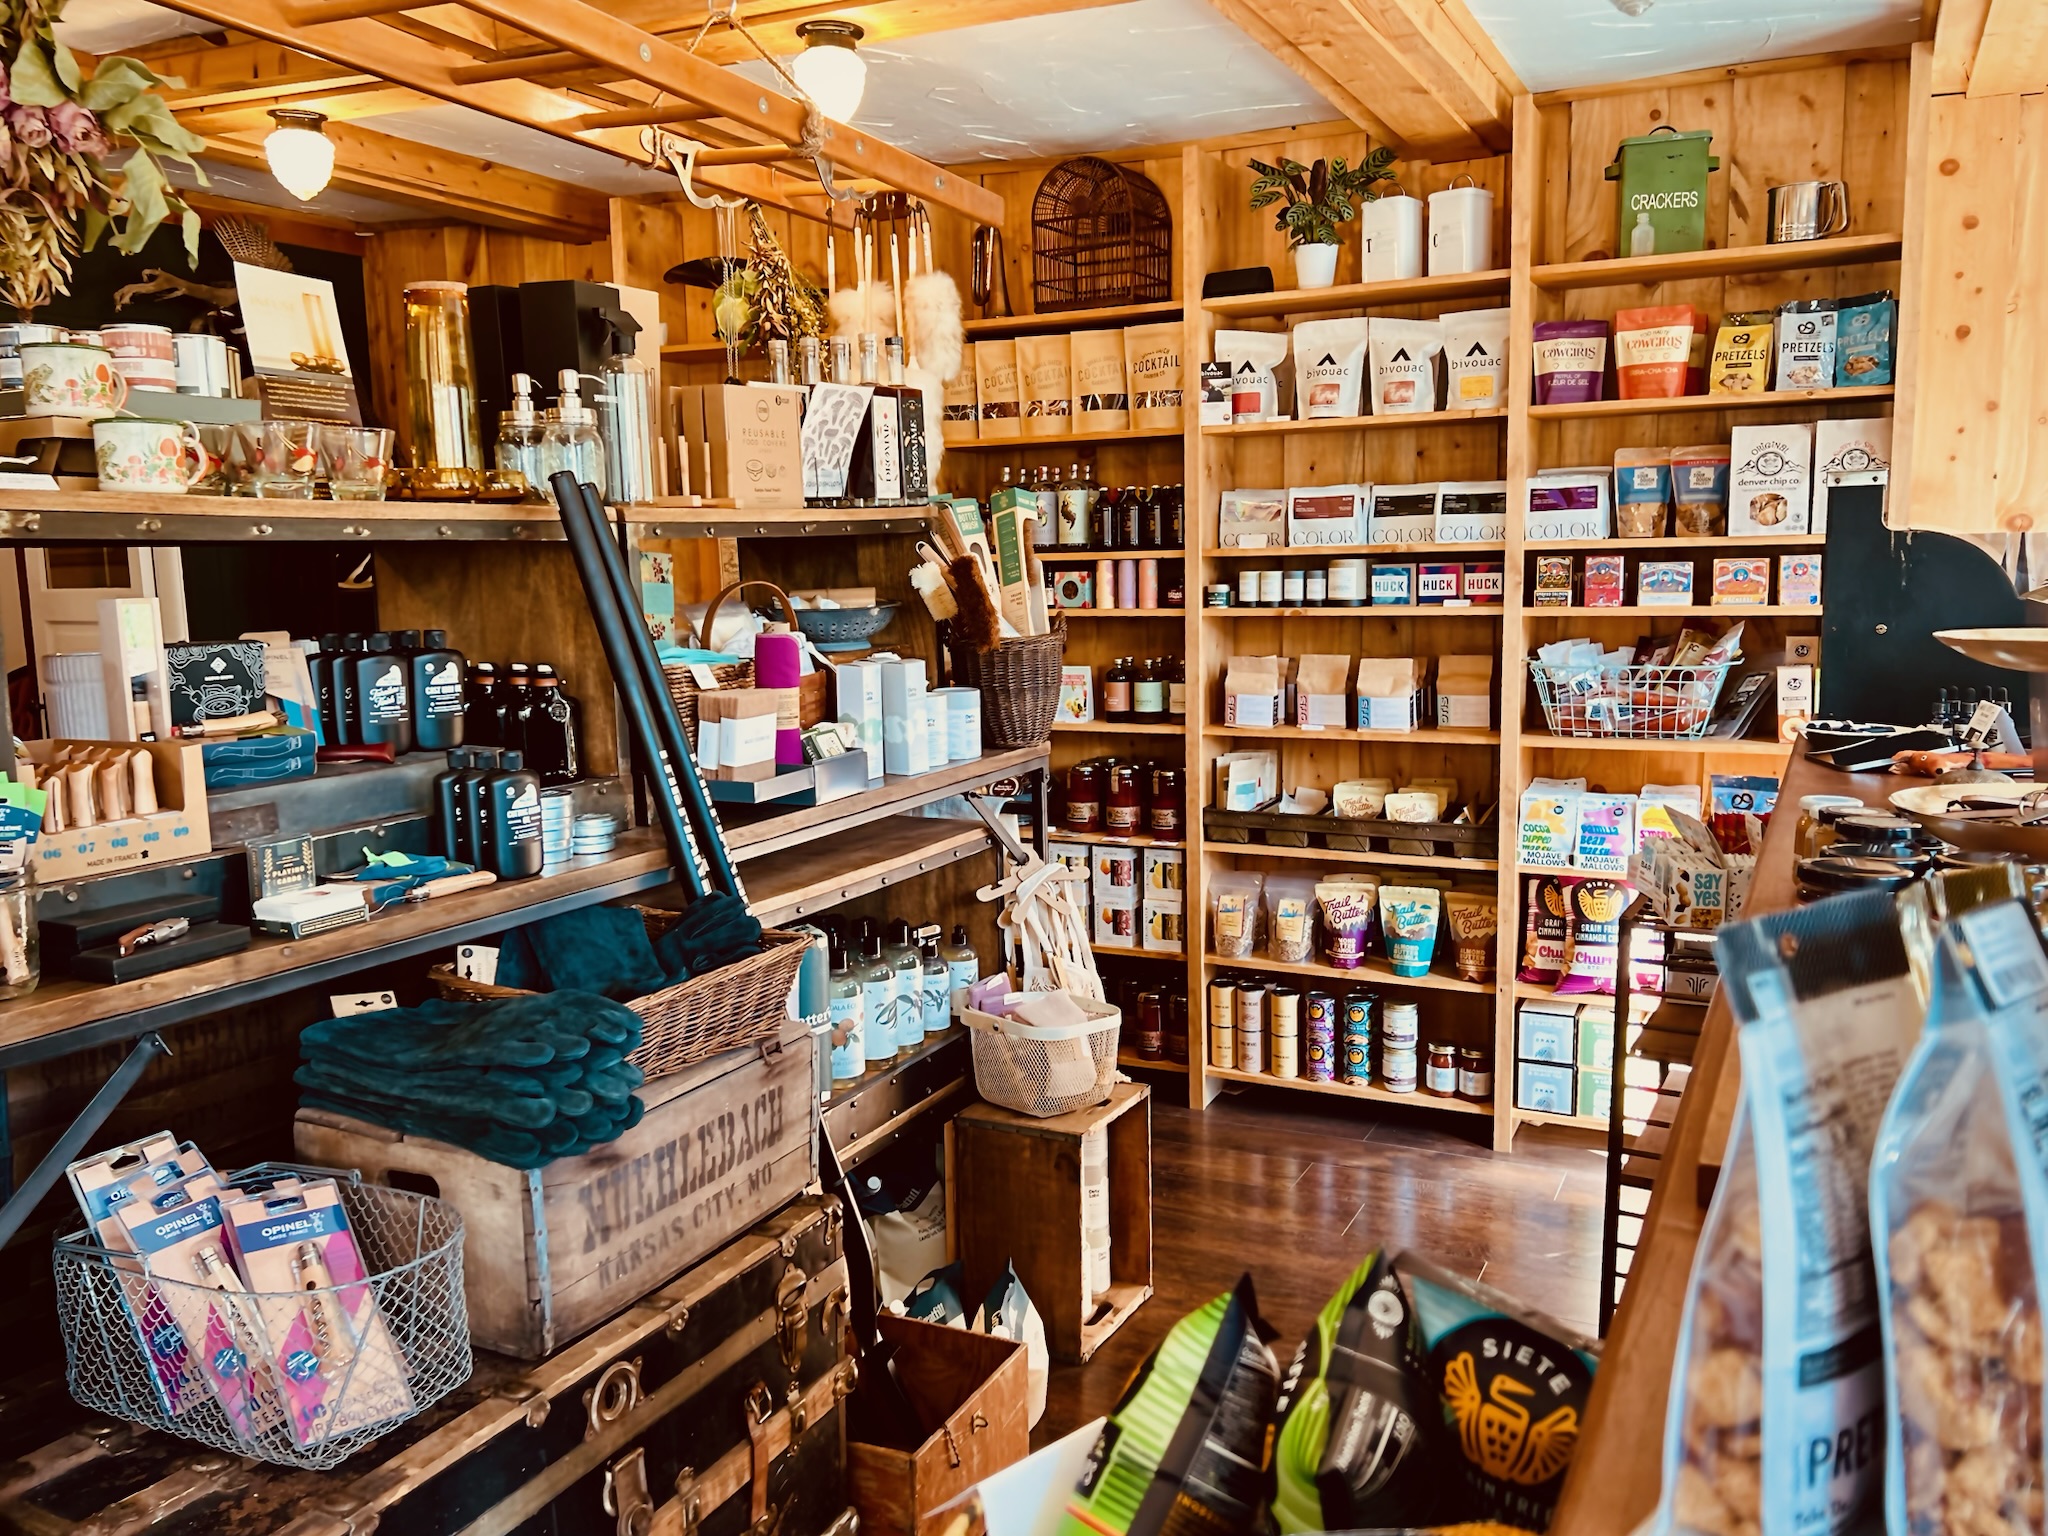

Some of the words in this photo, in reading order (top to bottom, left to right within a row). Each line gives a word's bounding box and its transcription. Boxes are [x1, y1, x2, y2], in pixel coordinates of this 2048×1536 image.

[1631, 191, 1698, 211] CRACKERS
[1366, 238, 1373, 253] T
[1626, 336, 1683, 351] COWGIRLS
[1837, 328, 1889, 346] PRETZELS
[1782, 342, 1834, 353] PRETZELS
[1542, 346, 1596, 363] COWGIRLS
[1715, 350, 1766, 362] PRETZELS
[1133, 355, 1181, 374] COCKTAIL
[1379, 363, 1423, 375] bivouac
[1451, 357, 1501, 370] bivouac
[1078, 362, 1124, 381] COCKTAI
[1306, 365, 1349, 379] bivouac
[984, 371, 1017, 389] COCKT
[1232, 375, 1268, 385] ivouac
[742, 428, 785, 439] REUSABLE
[1751, 441, 1791, 456] ORIGINAL
[1738, 478, 1767, 487] denver
[1769, 478, 1787, 487] chip
[958, 512, 978, 522] BOTTLE
[1293, 530, 1353, 545] COLOR
[1372, 528, 1434, 544] COLOR
[1439, 525, 1506, 542] COLOR
[1529, 522, 1598, 540] COLOR
[1375, 581, 1405, 592] HUCK
[1423, 580, 1453, 592] HUCK
[1468, 578, 1499, 590] HUCK
[1342, 796, 1362, 807] Trail
[1350, 804, 1374, 814] Butter
[143, 831, 160, 843] 08
[173, 826, 190, 838] 09
[78, 842, 96, 854] 07
[111, 837, 128, 848] 08
[43, 848, 62, 860] 06
[87, 858, 105, 867] MADE
[114, 852, 138, 864] FRANCE
[1527, 852, 1561, 860] MOJAVE
[1584, 856, 1620, 864] MOJAVE
[1523, 858, 1566, 867] MALLOWS
[1580, 863, 1625, 872] MALLOWS
[1641, 861, 1651, 871] BAR
[272, 865, 305, 878] PLAYING
[1323, 895, 1351, 912] Trail
[1387, 901, 1416, 917] Trail
[1332, 904, 1364, 923] Butter
[1453, 905, 1482, 922] Trail
[1397, 911, 1431, 930] Butter
[1461, 917, 1497, 934] Butter
[1538, 927, 1564, 937] CINNAMO
[1603, 924, 1619, 934] FRE
[1576, 932, 1606, 943] CINNAMON
[1539, 946, 1565, 958] Chu
[1576, 951, 1613, 966] Churr
[578, 1084, 784, 1256] MUEHLEBACH
[155, 1211, 203, 1237] OPINEL
[261, 1219, 312, 1237] OPINEL
[599, 1215, 685, 1290] KANSAS
[748, 1161, 773, 1198] MO
[1482, 1337, 1573, 1397] SIETE
[1808, 1410, 1876, 1489] PRE
